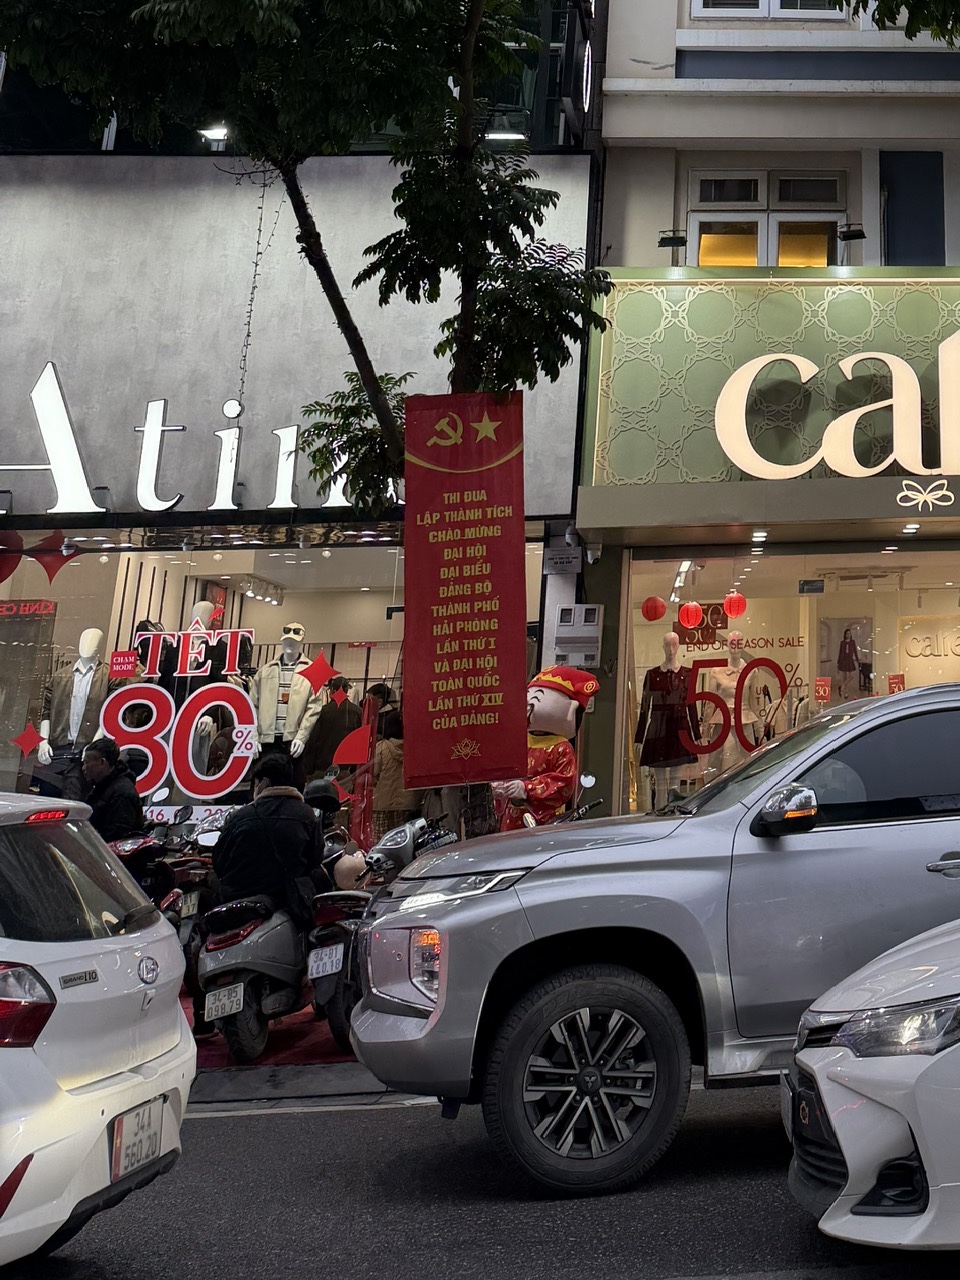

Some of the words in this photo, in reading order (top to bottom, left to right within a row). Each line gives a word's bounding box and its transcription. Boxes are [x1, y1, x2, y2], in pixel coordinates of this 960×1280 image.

[0, 361, 405, 514] Atin
[443, 492, 460, 504] THI
[464, 490, 487, 503] ĐUA
[416, 511, 440, 527] LẬP
[444, 508, 482, 523] THÀNH
[486, 505, 513, 519] TÍCH
[429, 528, 461, 543] CHÀO
[464, 524, 502, 539] MỪNG
[444, 547, 463, 561] ĐẠI
[466, 543, 487, 559] HỘI
[440, 566, 459, 580] ĐẠI
[439, 581, 472, 598] ĐẢNG
[475, 580, 492, 596] BỘ
[431, 602, 471, 617] THÀNH
[474, 595, 500, 613] PHỐ
[433, 620, 453, 636] HẢI
[456, 618, 498, 633] PHÒNG
[463, 636, 487, 651] THỨ
[488, 637, 496, 649] I
[730, 637, 774, 650] SEASON
[778, 636, 805, 648] SALE
[112, 663, 134, 672] MODE
[434, 658, 450, 673] VÀ
[453, 658, 472, 672] ĐẠI
[476, 654, 497, 671] HỘI
[431, 676, 463, 693] TOÀN
[467, 671, 500, 689] QUỐC
[456, 693, 481, 708] THỨ
[481, 692, 504, 707] XIV
[433, 713, 457, 730] CỦA
[461, 709, 499, 726] ĐẢNG!
[207, 998, 241, 1019] 098.79
